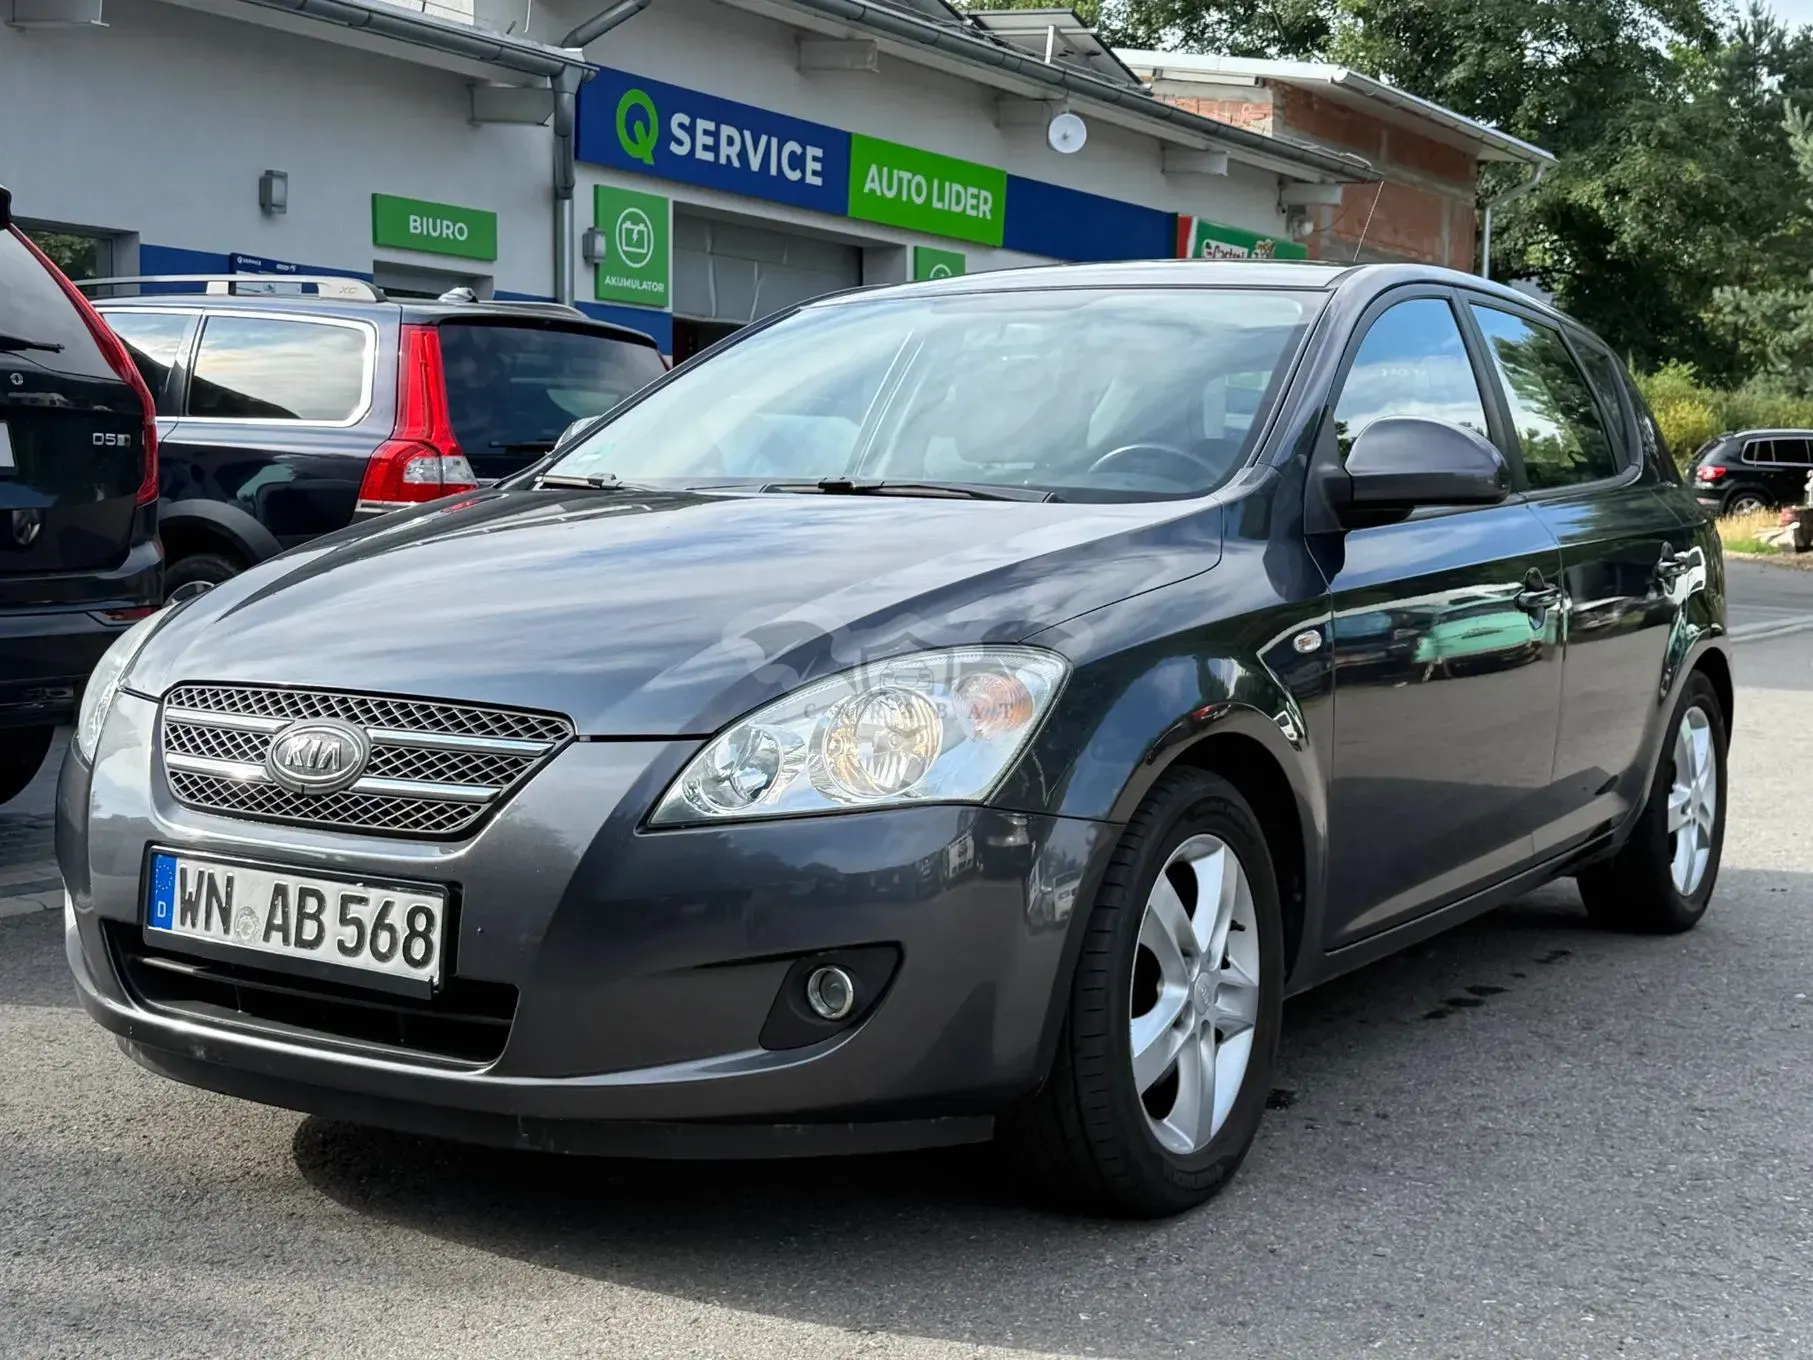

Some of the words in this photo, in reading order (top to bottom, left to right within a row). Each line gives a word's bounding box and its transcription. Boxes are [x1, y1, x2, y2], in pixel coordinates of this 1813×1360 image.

[669, 112, 823, 186] SERVICE
[863, 163, 928, 205] AUTO
[932, 178, 993, 220] LIDER
[408, 214, 468, 241] BIURO
[604, 275, 665, 293] AKUMULATOR
[284, 737, 342, 771] KIA
[156, 900, 167, 919] D
[179, 865, 235, 936] WN
[261, 881, 328, 951] AB
[336, 891, 436, 969] 568
